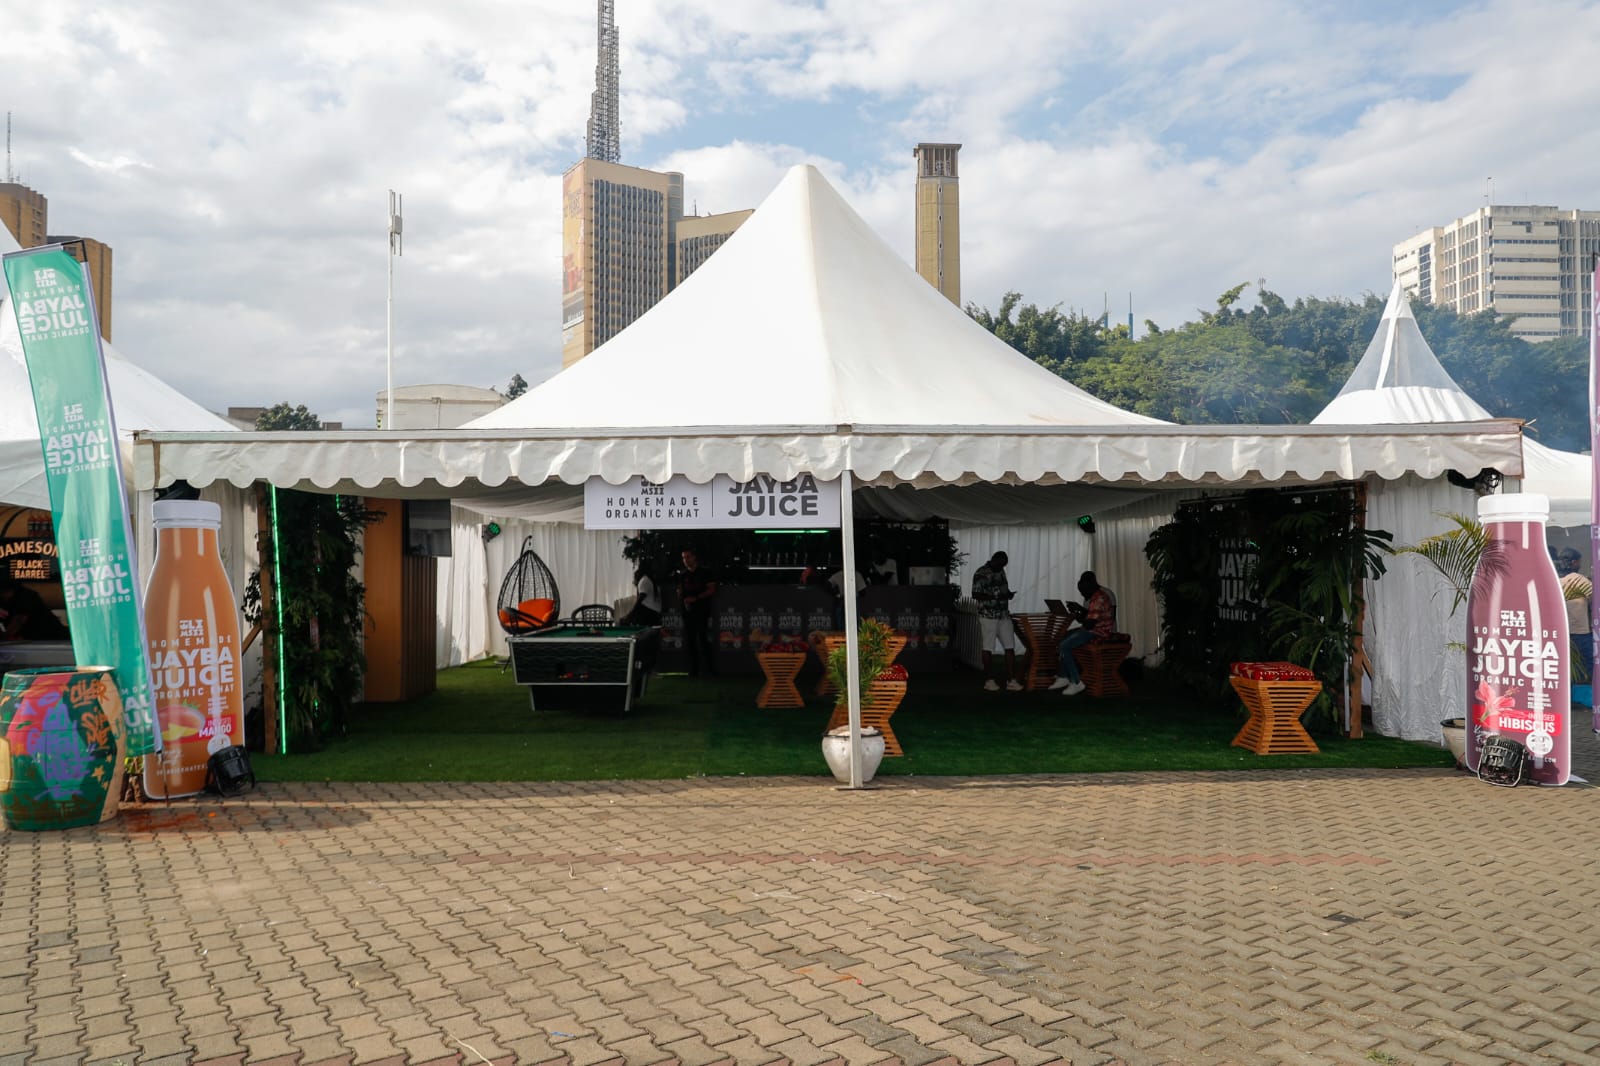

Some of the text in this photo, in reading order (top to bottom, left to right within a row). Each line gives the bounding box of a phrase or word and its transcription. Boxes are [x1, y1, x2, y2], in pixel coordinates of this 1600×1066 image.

[728, 474, 818, 494] JAYBA
[607, 497, 698, 507] HOMEMADE
[728, 495, 818, 517] JUICE
[606, 509, 699, 519] ORGANIC KHAT
[17, 559, 43, 569] BLACK
[14, 569, 46, 579] BARREL
[152, 635, 232, 649] HOMEMDE
[1472, 637, 1560, 660] JAYBA
[150, 646, 233, 670] JAYBA
[1472, 655, 1560, 680] JUICE
[152, 664, 234, 690] JUICE
[1474, 674, 1525, 687] ORGANIC
[210, 684, 234, 695] HAT
[1499, 717, 1555, 733] HIBISCUS
